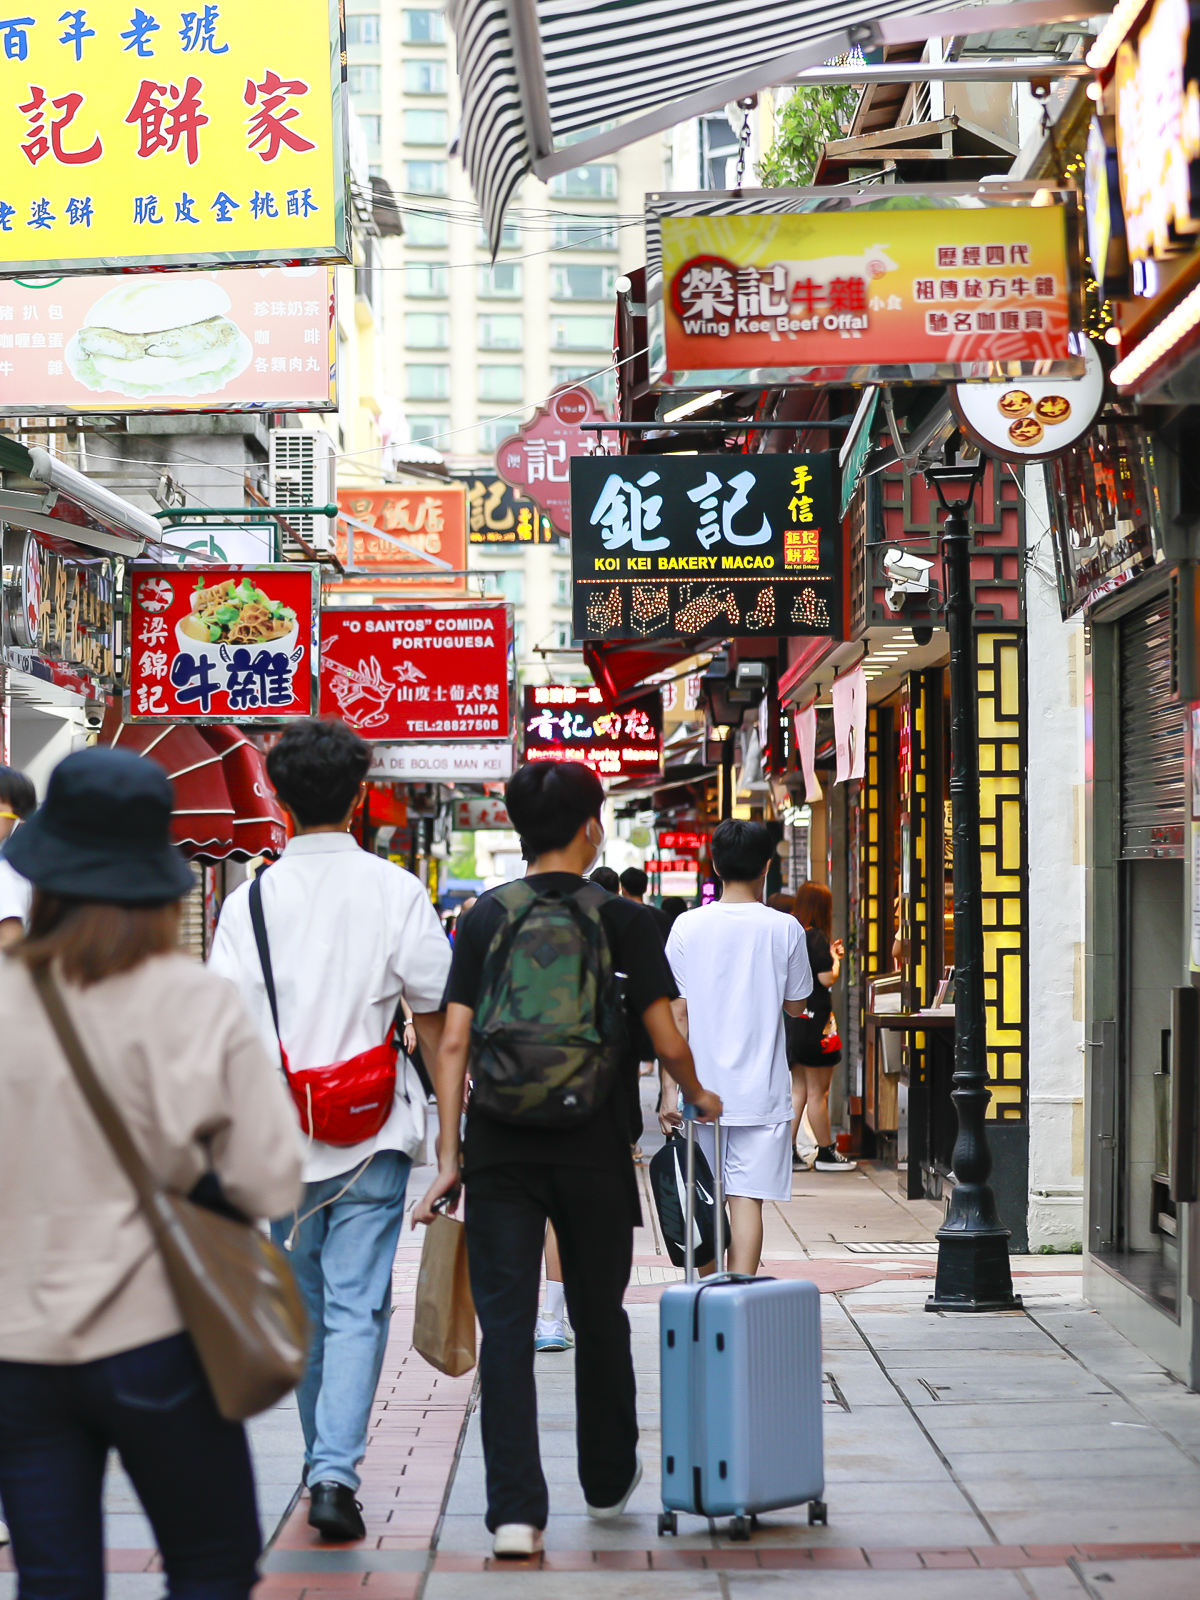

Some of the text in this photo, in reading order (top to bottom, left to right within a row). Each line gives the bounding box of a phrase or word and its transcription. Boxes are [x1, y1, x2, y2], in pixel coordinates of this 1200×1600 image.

[132, 187, 320, 226] 脆皮金桃酥
[680, 265, 902, 320] 榮記 牛雜 小食
[253, 300, 320, 317] 珍珠奶茶
[683, 314, 868, 337] Wing Kee Beef Offal
[254, 328, 320, 345] 咖啡
[253, 356, 321, 373] 各類肉丸
[787, 465, 814, 523] 手信
[589, 470, 773, 552] 鉅記
[594, 555, 775, 571] KOI KEI BAKERY MACAO
[435, 618, 495, 632] COMIDA
[392, 635, 495, 650] PORTUGUESA
[137, 616, 169, 713] 梁錦記
[455, 704, 498, 716] TAIPA
[407, 719, 499, 732] TEL:28827508
[390, 758, 405, 769] DE
[411, 757, 449, 769] BOLOS
[453, 759, 478, 769] MAN
[483, 759, 502, 769] KEI
